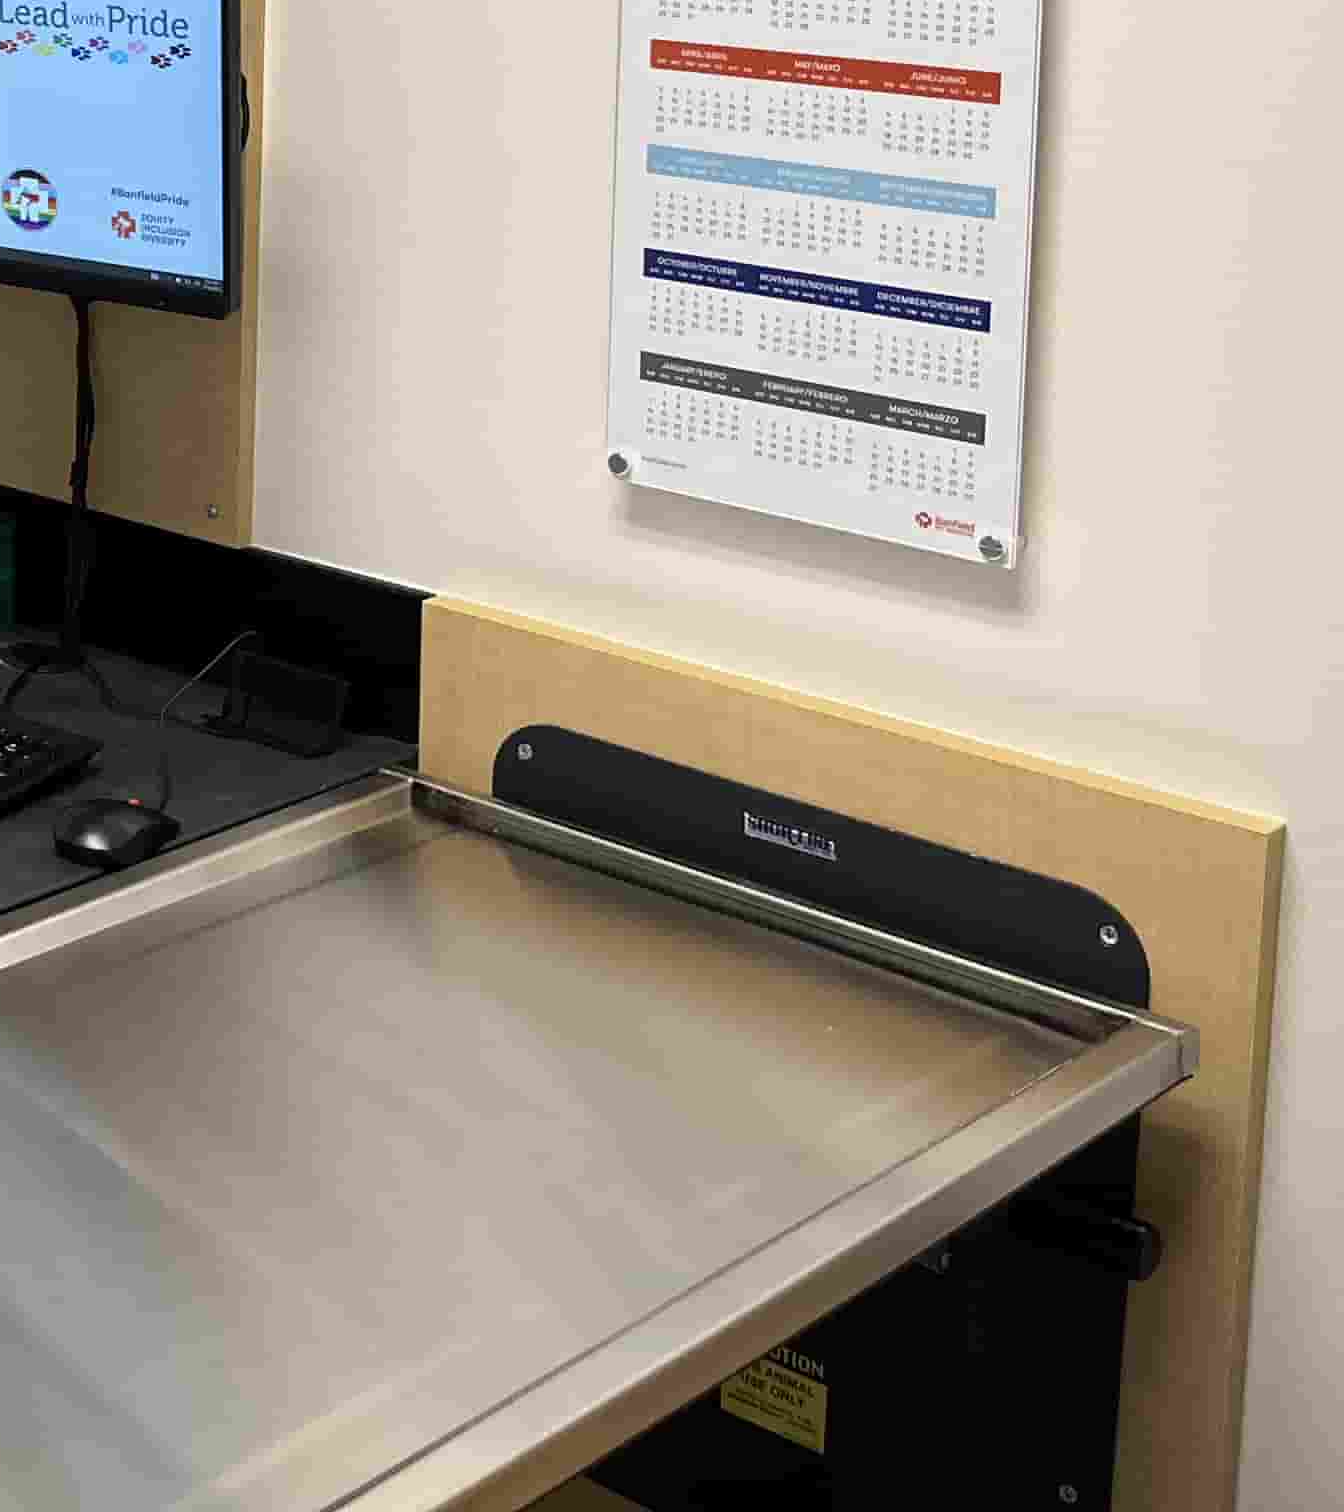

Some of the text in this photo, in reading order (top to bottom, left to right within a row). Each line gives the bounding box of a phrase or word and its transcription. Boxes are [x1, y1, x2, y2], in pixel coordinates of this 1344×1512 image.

[72, 12, 105, 27] with
[107, 4, 189, 39] Pride
[769, 1347, 825, 1379] UTION
